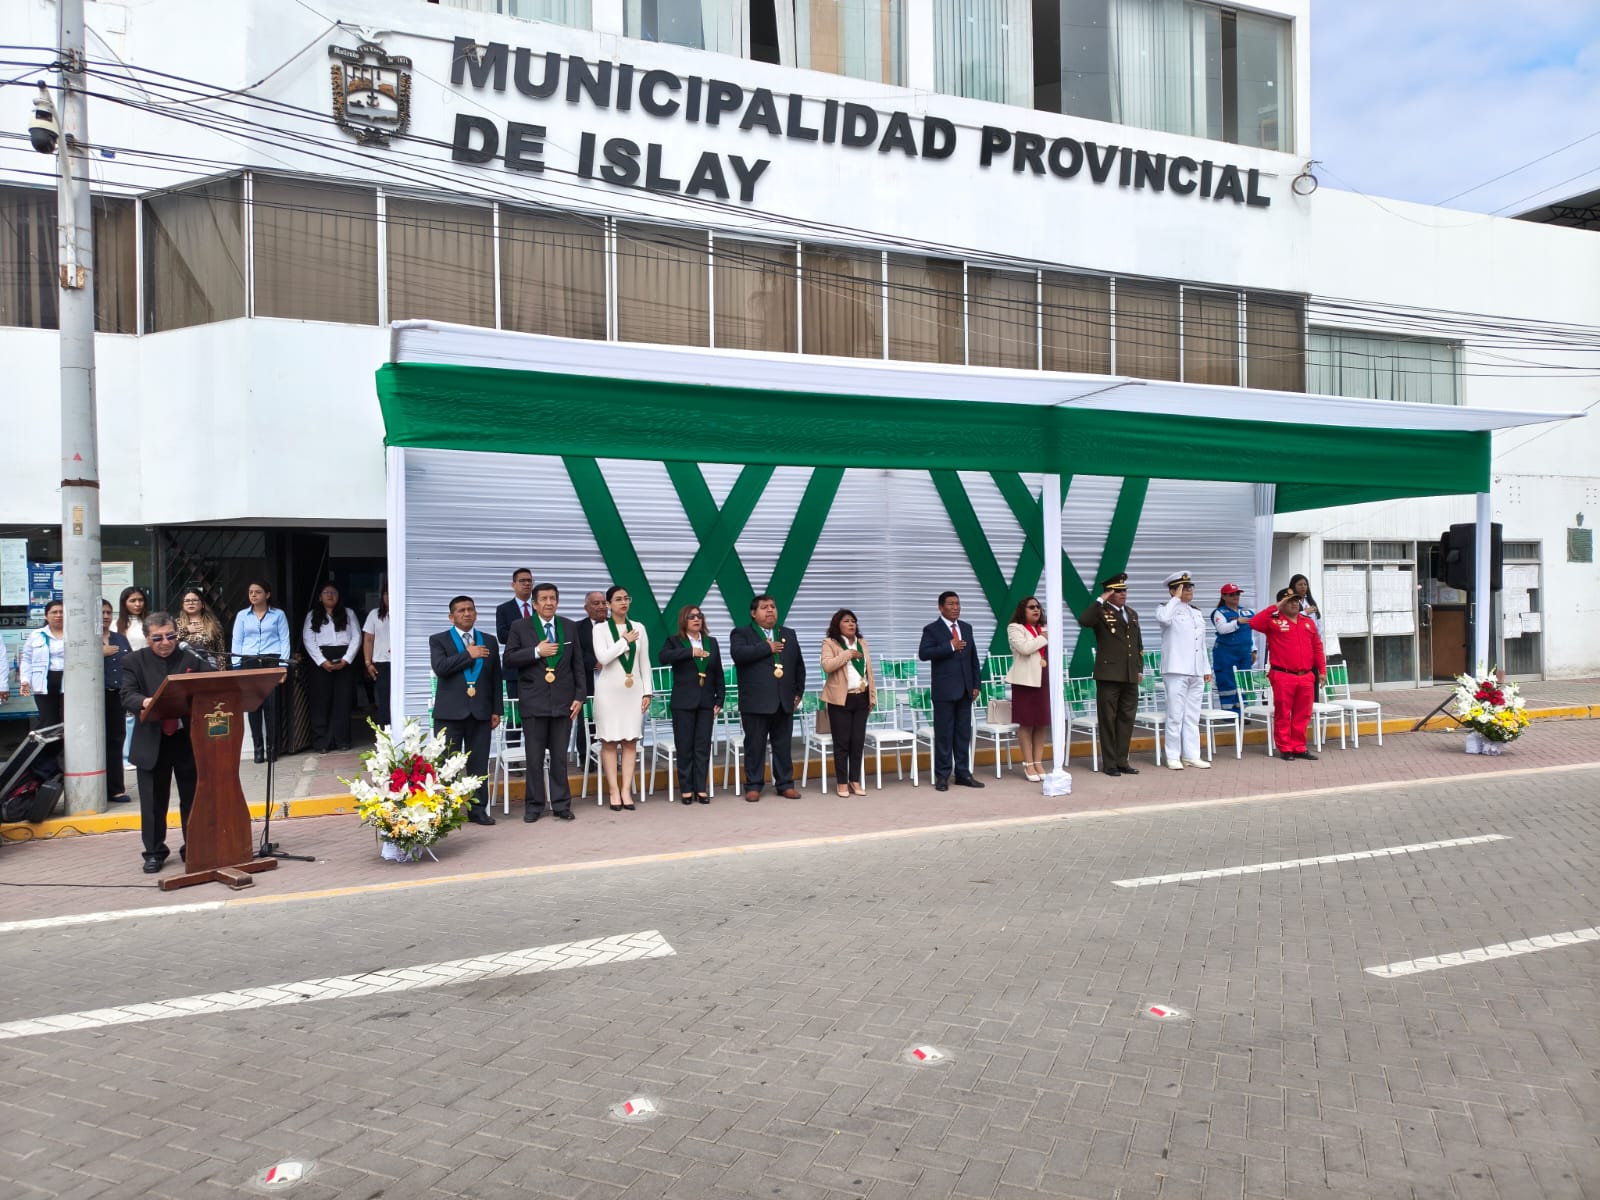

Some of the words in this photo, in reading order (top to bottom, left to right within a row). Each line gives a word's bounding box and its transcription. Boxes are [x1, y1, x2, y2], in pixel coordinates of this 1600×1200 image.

[451, 36, 957, 159] MUNICIPALIDAD
[980, 125, 1271, 207] PROVINCIAL
[452, 113, 547, 172] DE
[578, 131, 771, 201] ISLAY
